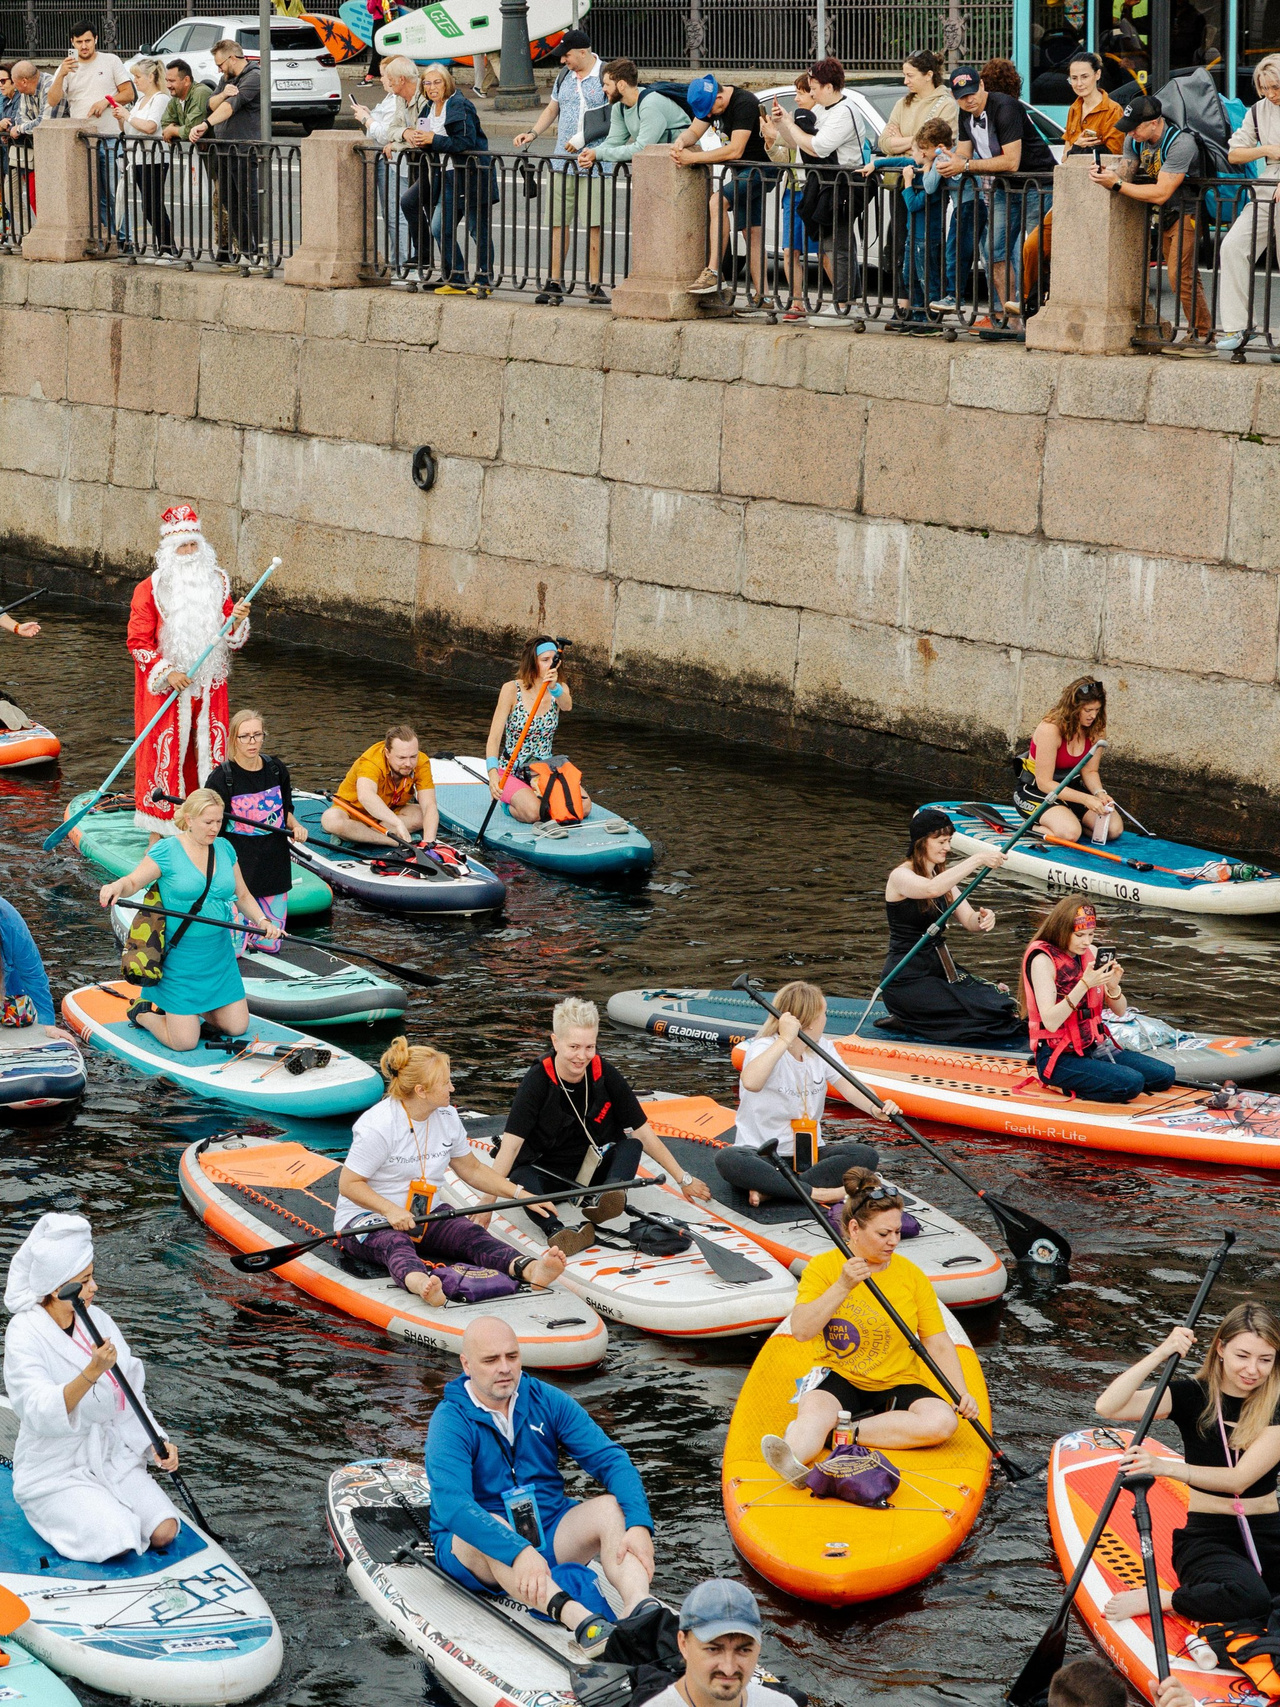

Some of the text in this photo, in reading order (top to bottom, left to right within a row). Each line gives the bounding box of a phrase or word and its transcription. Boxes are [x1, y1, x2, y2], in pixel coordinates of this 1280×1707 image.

[1114, 883, 1140, 902] 10.8
[668, 1025, 719, 1042] GLADIATOR
[1003, 1121, 1088, 1142] Feath-R-Lite
[586, 1296, 615, 1316] SHARK
[828, 1324, 848, 1333] УРА!
[829, 1332, 850, 1341] ДУГА
[403, 1329, 438, 1347] SHARK
